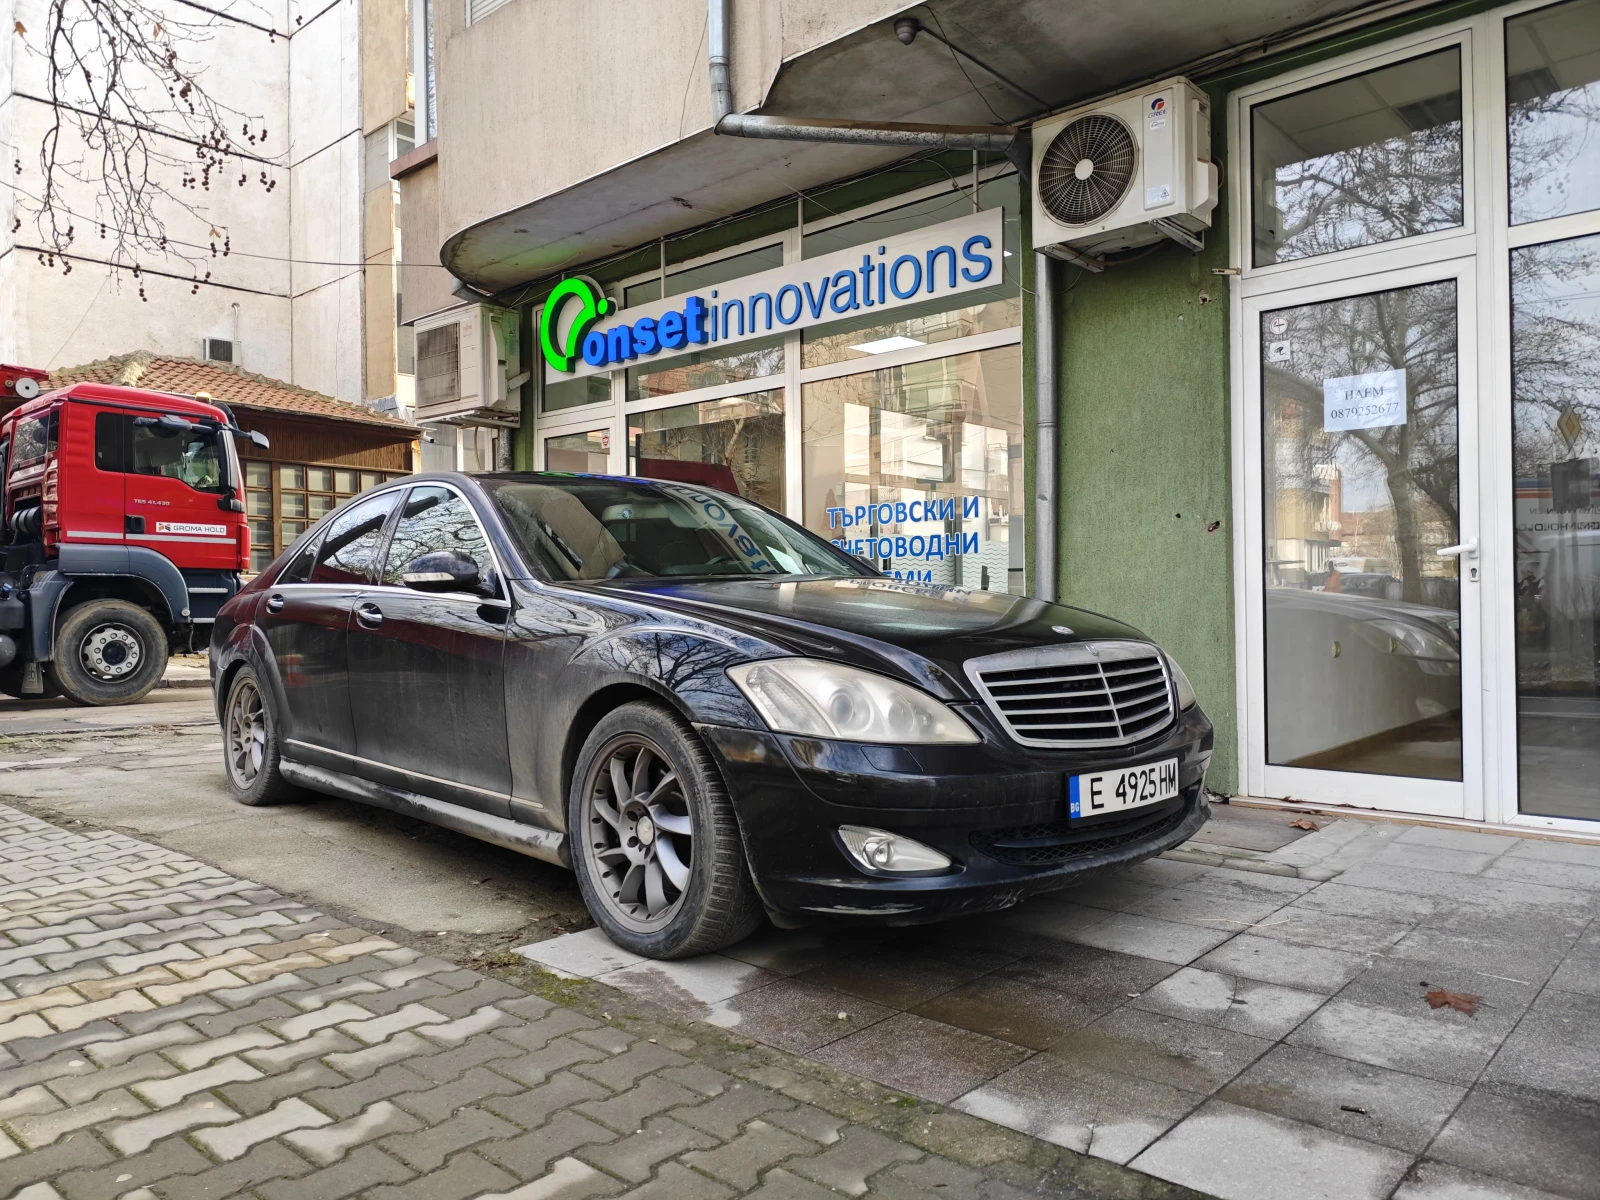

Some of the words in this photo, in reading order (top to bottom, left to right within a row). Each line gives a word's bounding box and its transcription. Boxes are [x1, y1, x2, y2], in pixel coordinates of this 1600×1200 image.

[1148, 109, 1168, 118] GREE
[1344, 386, 1384, 400] НАЕМ
[1330, 402, 1399, 419] 0879252677
[826, 497, 955, 529] ТЪРГОВСКИ
[962, 495, 979, 520] И
[173, 524, 203, 532] GROMA
[204, 525, 225, 534] HOLD
[1090, 776, 1104, 810] E
[1070, 802, 1080, 813] BG
